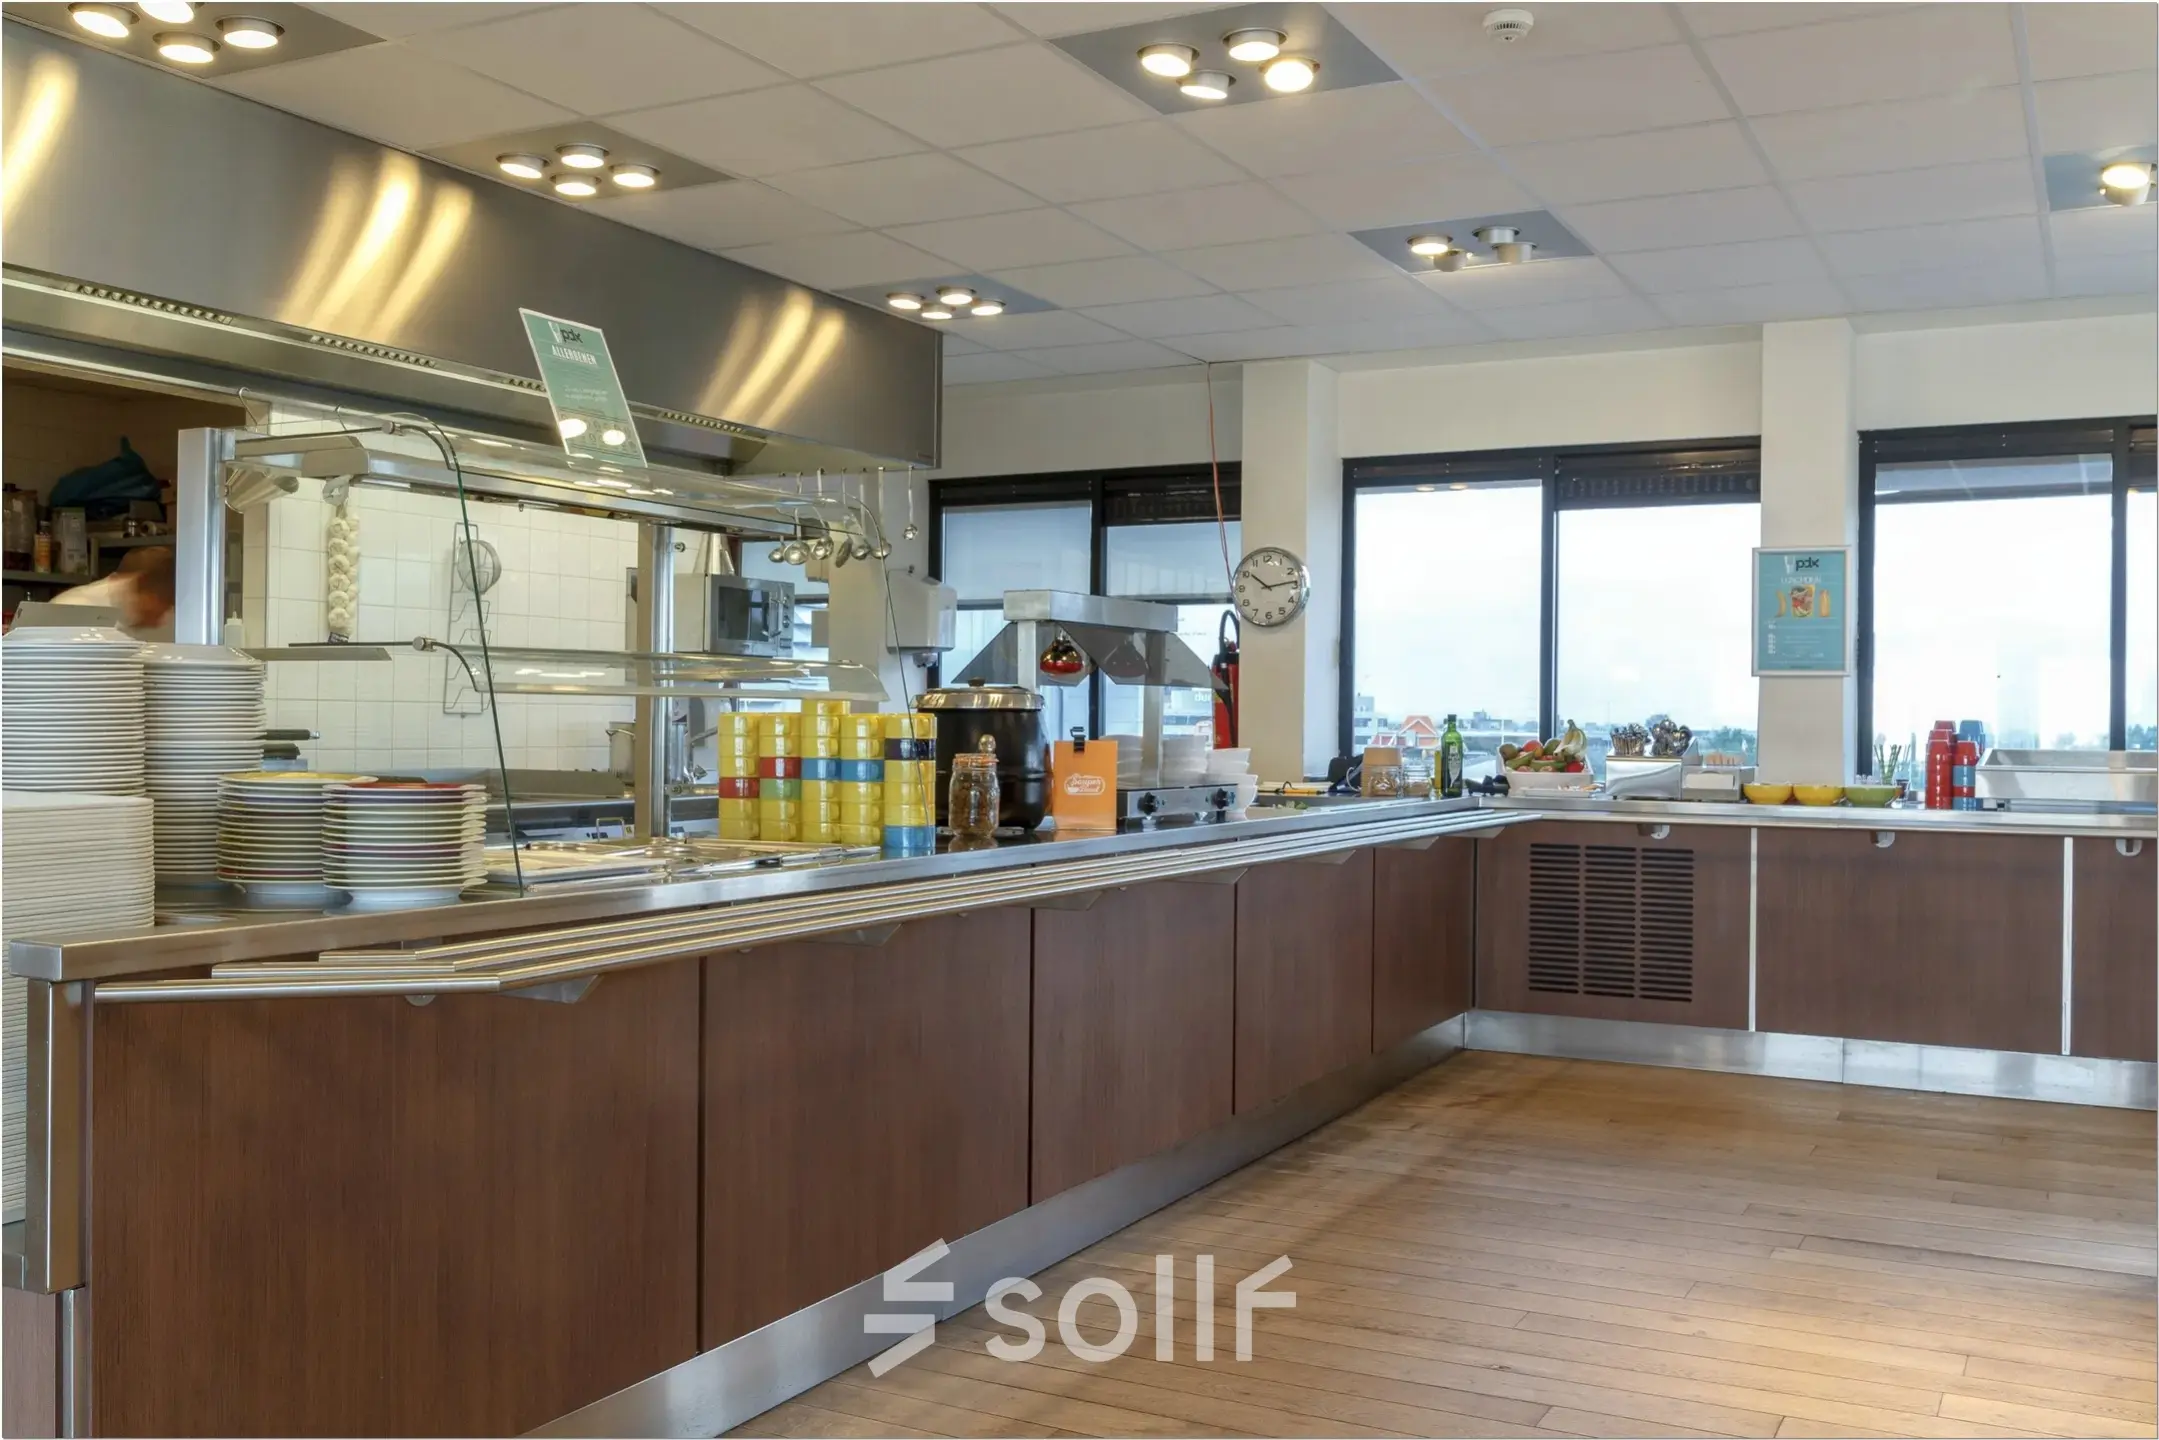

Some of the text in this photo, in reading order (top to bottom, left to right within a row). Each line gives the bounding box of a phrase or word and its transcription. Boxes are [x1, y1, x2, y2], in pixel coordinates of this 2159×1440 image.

[1263, 555, 1272, 563] 12
[1252, 560, 1259, 568] 11
[1242, 570, 1250, 579] 10
[1287, 567, 1294, 576] 2
[1238, 585, 1246, 593] 9
[1291, 580, 1299, 590] 3
[1242, 599, 1250, 607] 8
[1287, 595, 1295, 604] 4
[1252, 608, 1259, 617] 7
[1265, 611, 1273, 620] 6
[1278, 607, 1286, 615] 5
